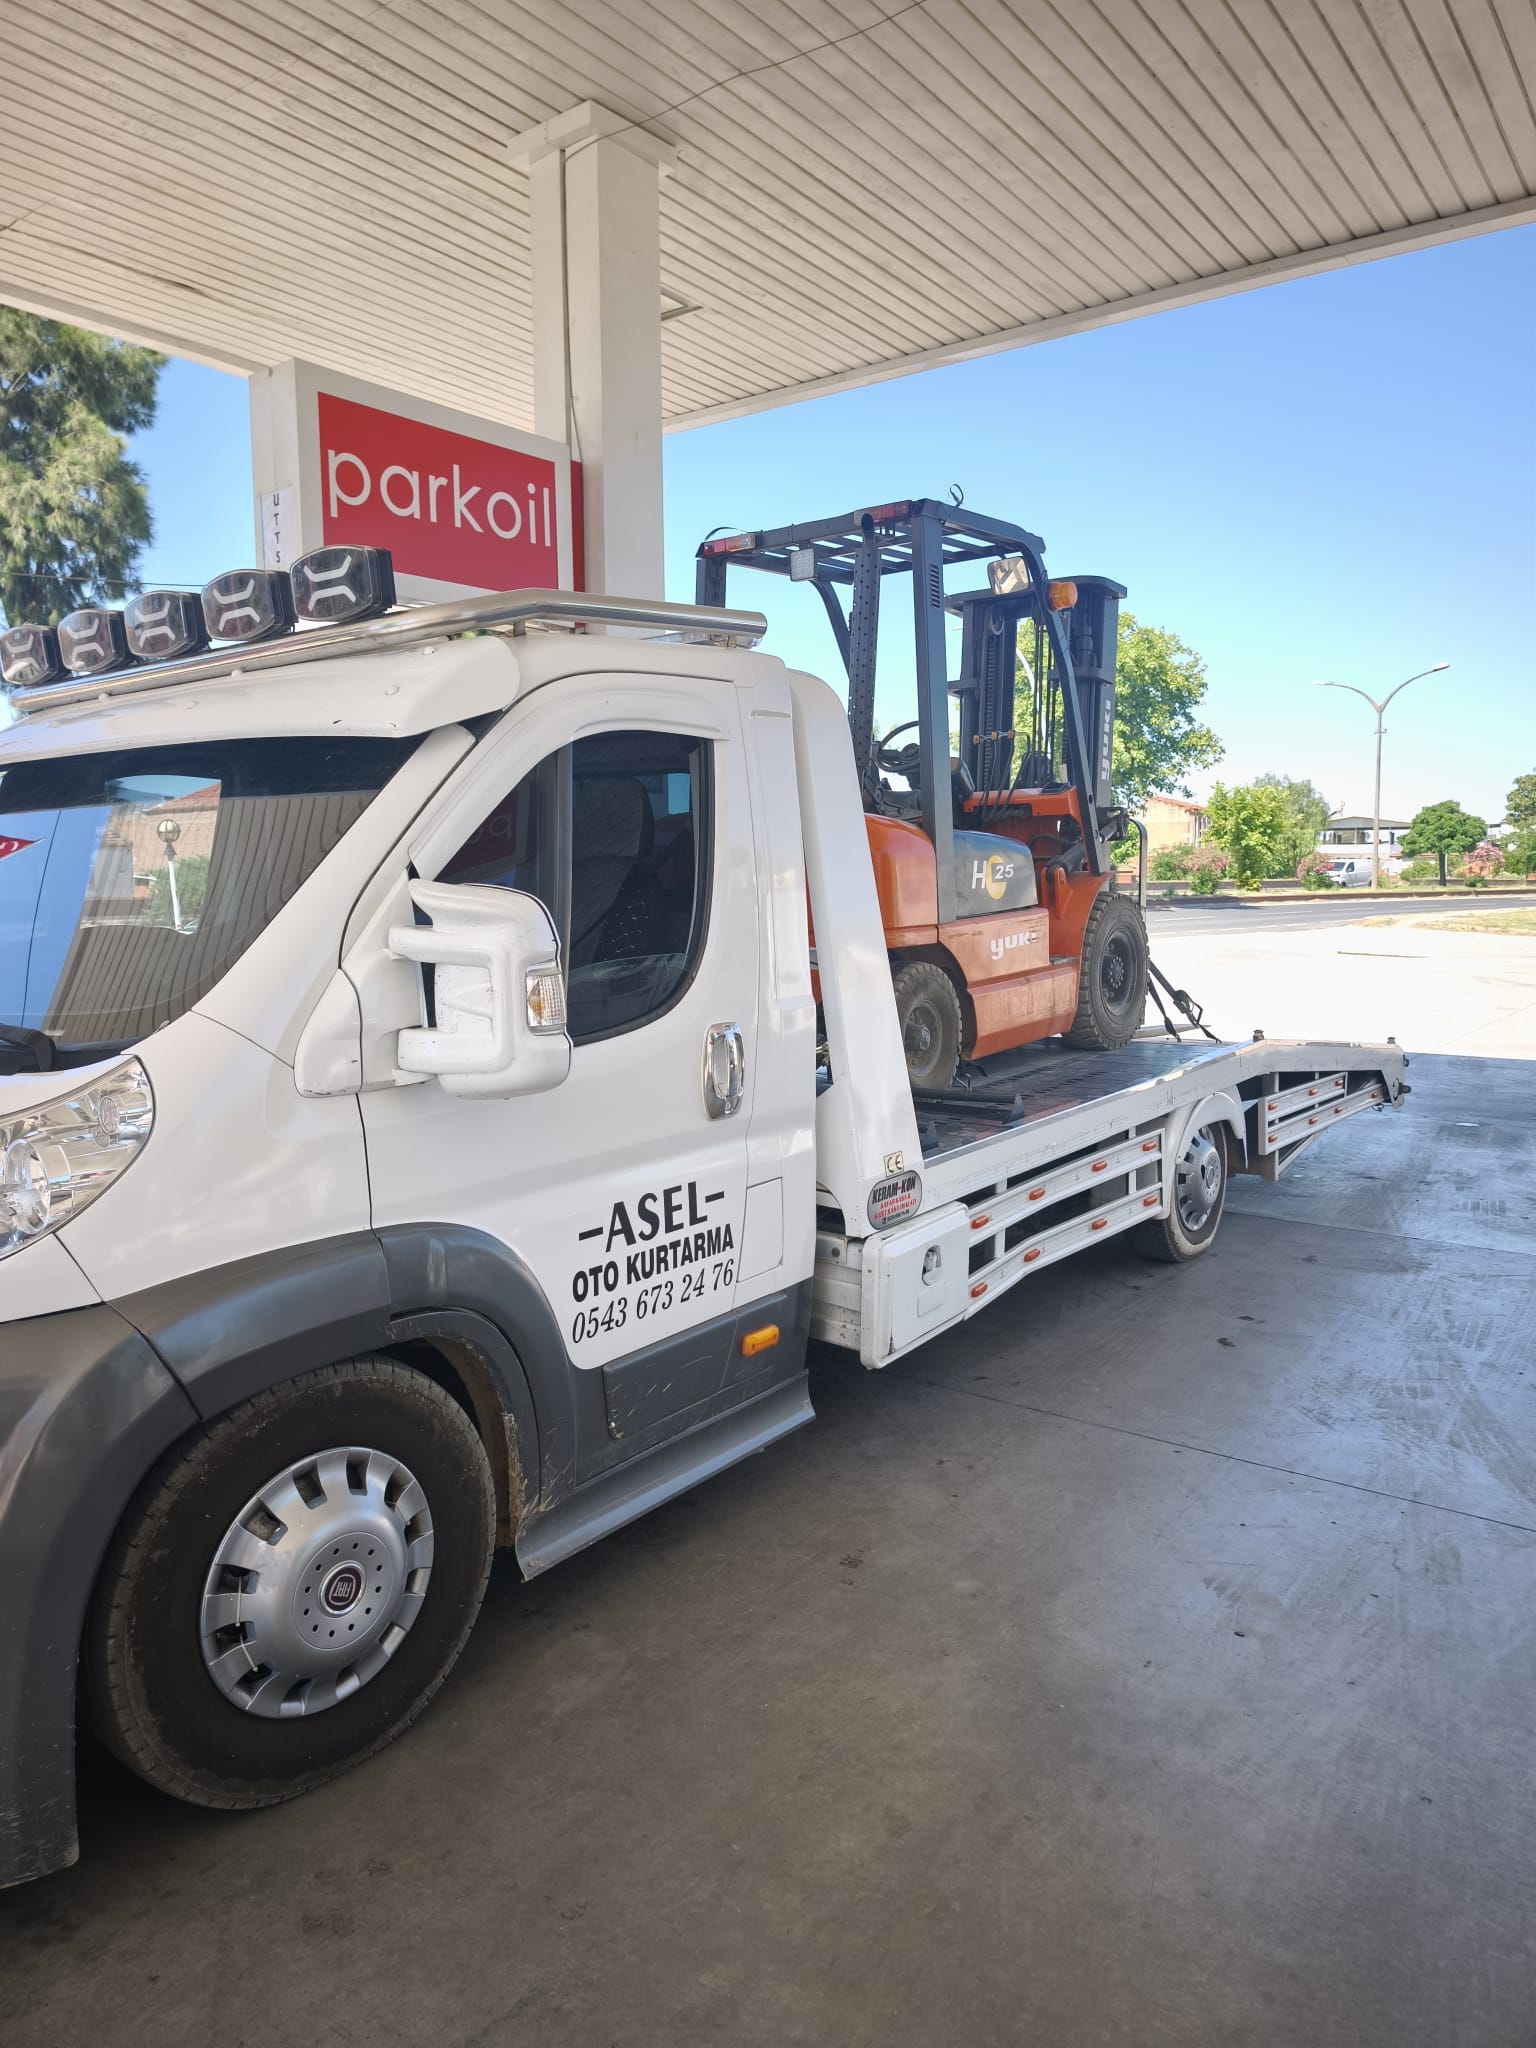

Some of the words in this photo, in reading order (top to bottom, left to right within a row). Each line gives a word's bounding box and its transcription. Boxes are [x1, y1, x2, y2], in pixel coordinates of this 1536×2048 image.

[272, 493, 281, 564] UTTS
[327, 448, 552, 547] parkoil
[572, 1260, 619, 1303] OTO
[626, 1223, 734, 1285] KURTARMA
[572, 1297, 628, 1344] 0543
[636, 1280, 674, 1320] 673
[680, 1267, 705, 1304] 24
[712, 1258, 734, 1291] 76
